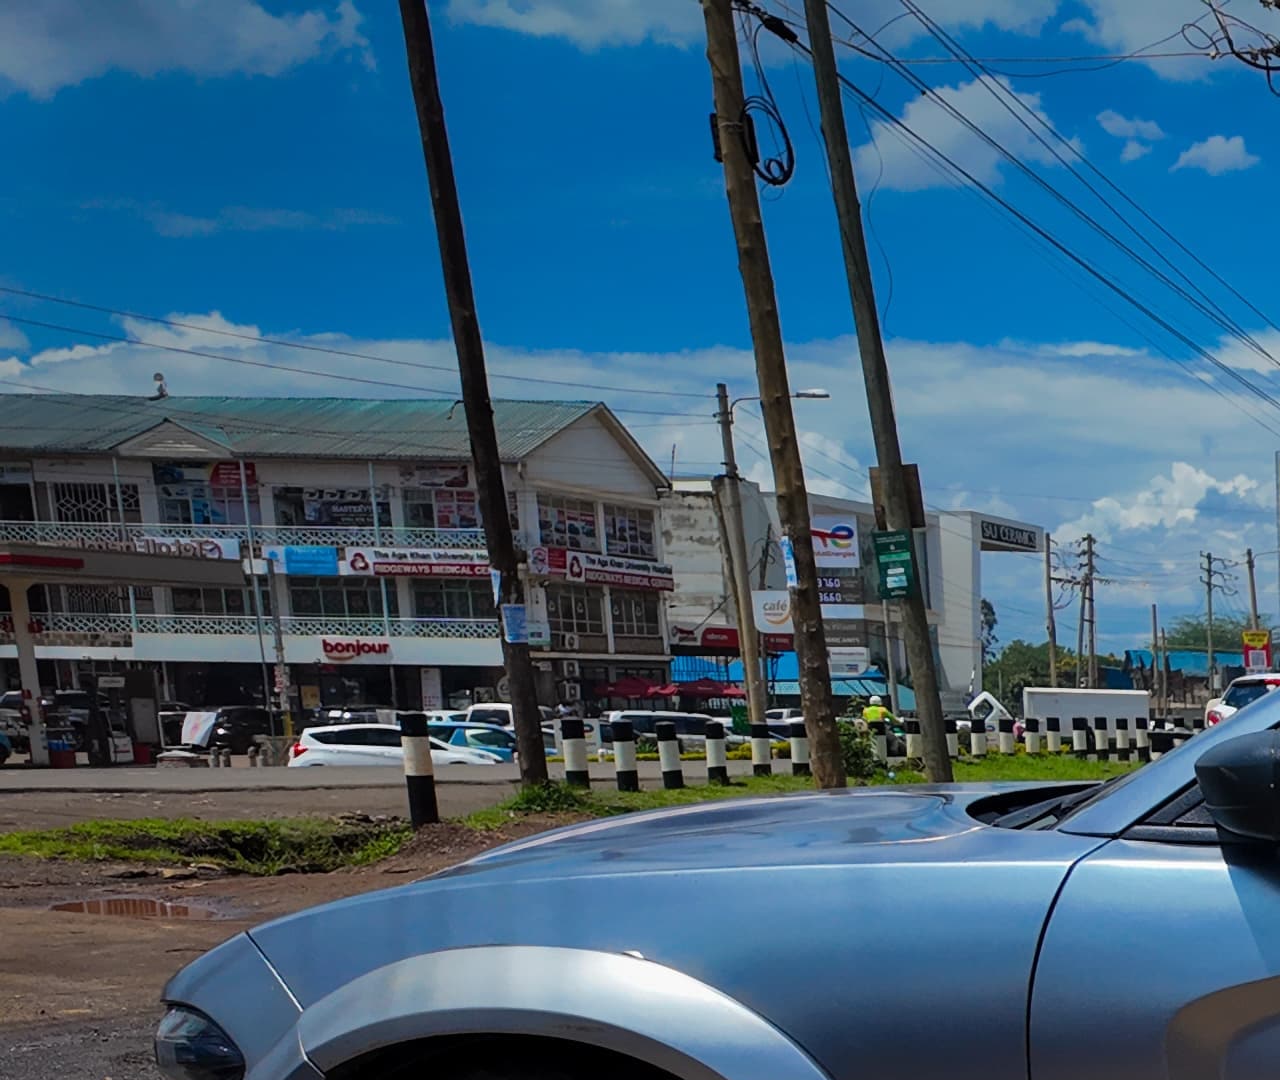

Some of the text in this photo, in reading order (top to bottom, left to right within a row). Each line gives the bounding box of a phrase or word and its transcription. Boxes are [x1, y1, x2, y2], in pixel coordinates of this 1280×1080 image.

[373, 550, 389, 560] The
[391, 551, 407, 561] Aga
[409, 551, 429, 560] Khan
[433, 551, 475, 562] University
[321, 638, 390, 657] bonjour
